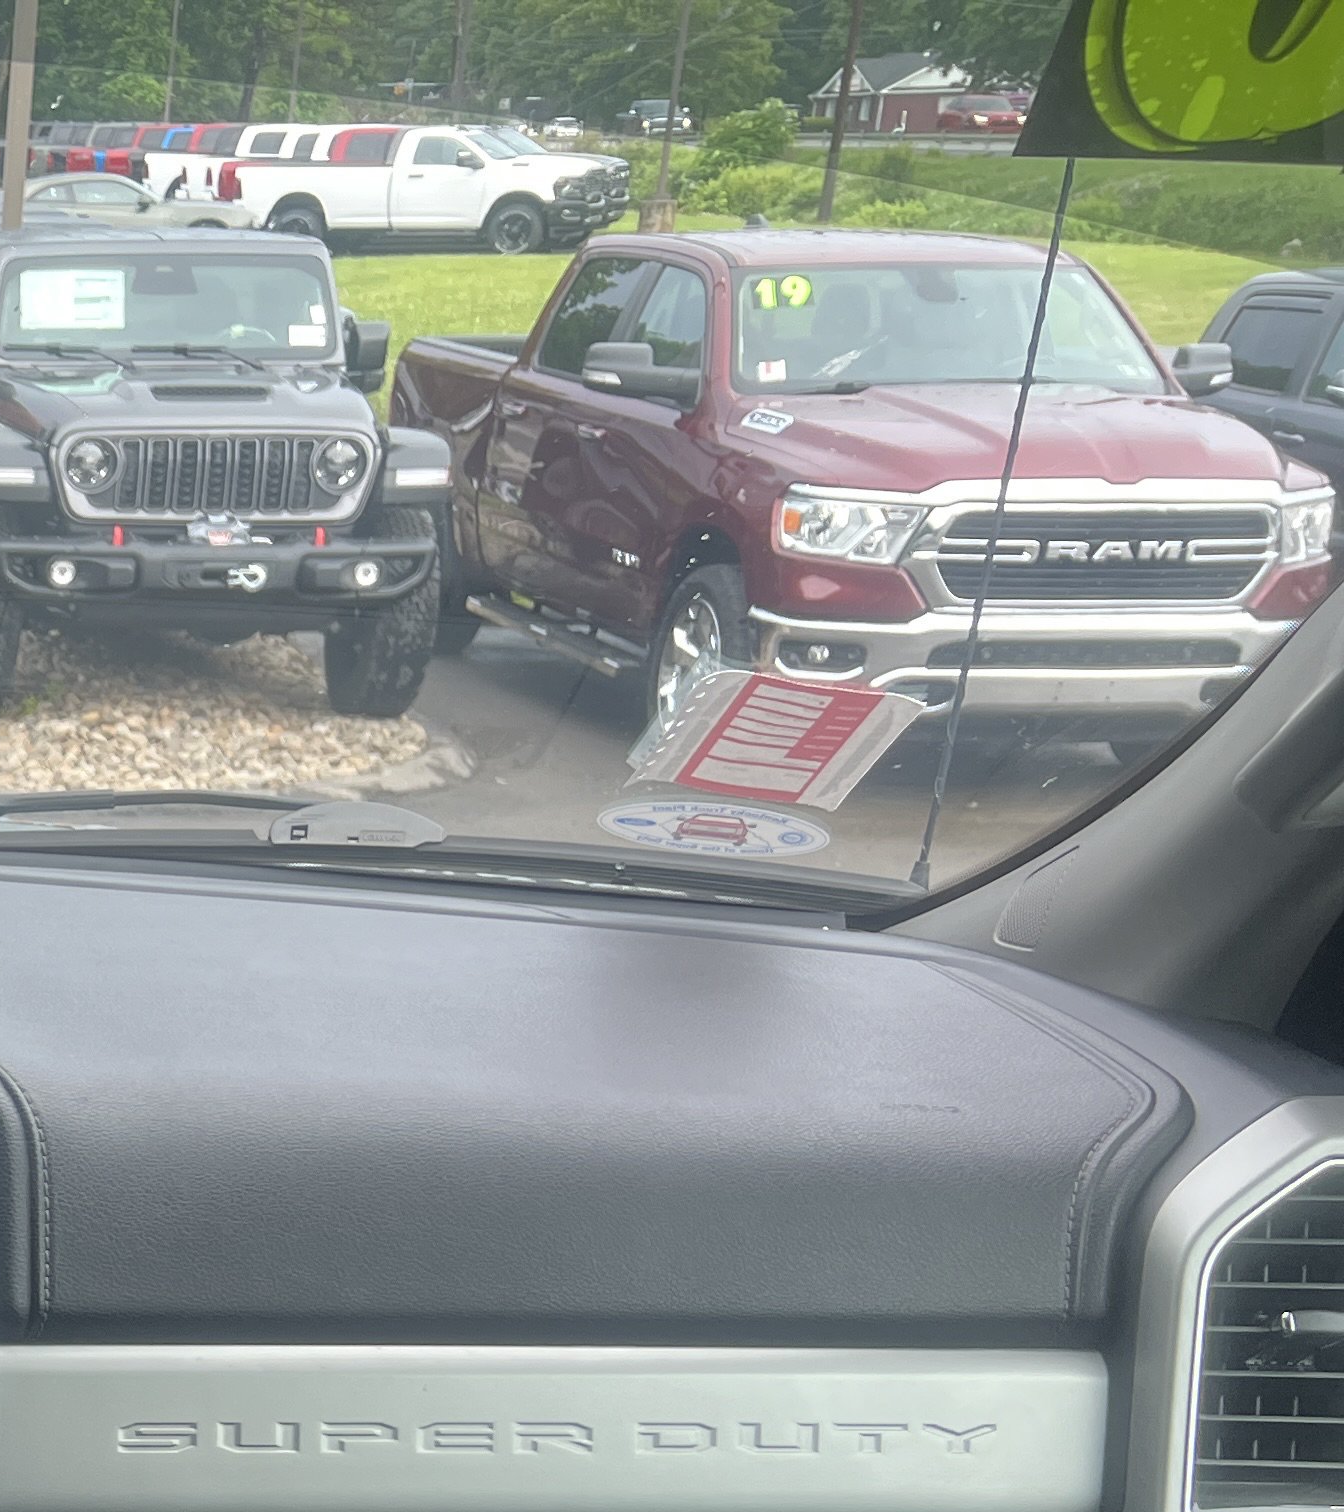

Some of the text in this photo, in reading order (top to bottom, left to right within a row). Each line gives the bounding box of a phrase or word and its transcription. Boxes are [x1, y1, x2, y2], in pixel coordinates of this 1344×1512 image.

[755, 274, 812, 310] 19
[1045, 539, 1184, 562] RAM
[115, 1420, 999, 1456] SUPER DUTY
